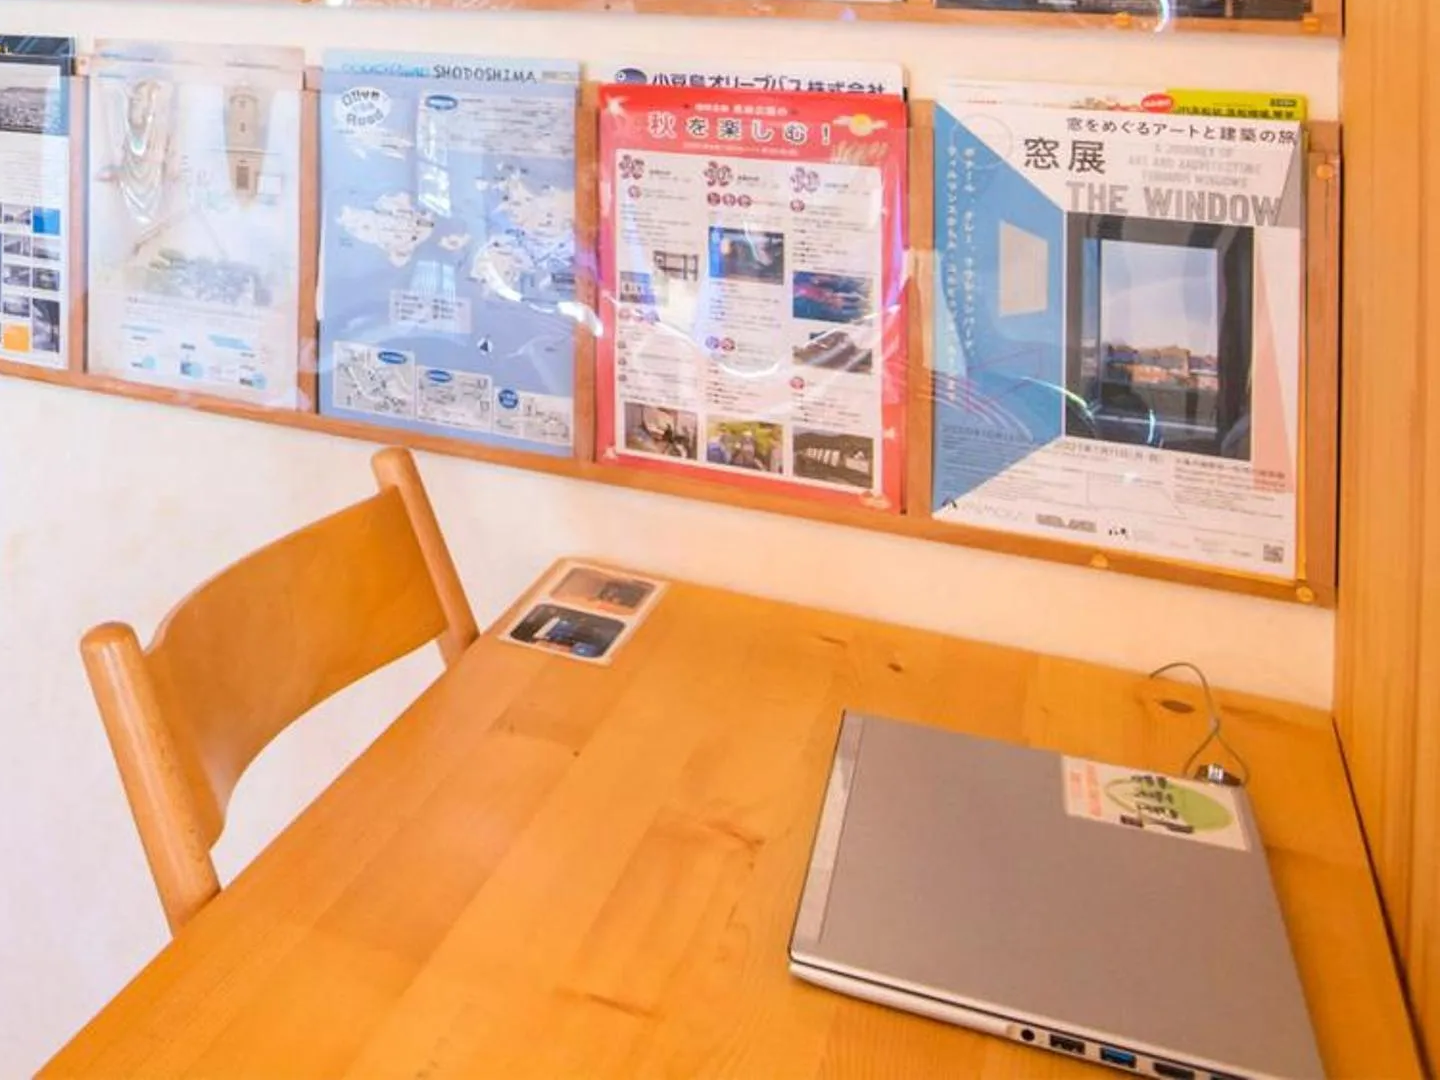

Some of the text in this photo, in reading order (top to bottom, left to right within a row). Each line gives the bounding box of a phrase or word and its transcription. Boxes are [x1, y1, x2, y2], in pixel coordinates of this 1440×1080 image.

[432, 65, 538, 85] SHODOSHIMA
[1066, 117, 1298, 145] 窓をめぐるアートと建築の旅
[1024, 136, 1107, 175] 窓展
[1066, 181, 1283, 226] THE WINDOW
